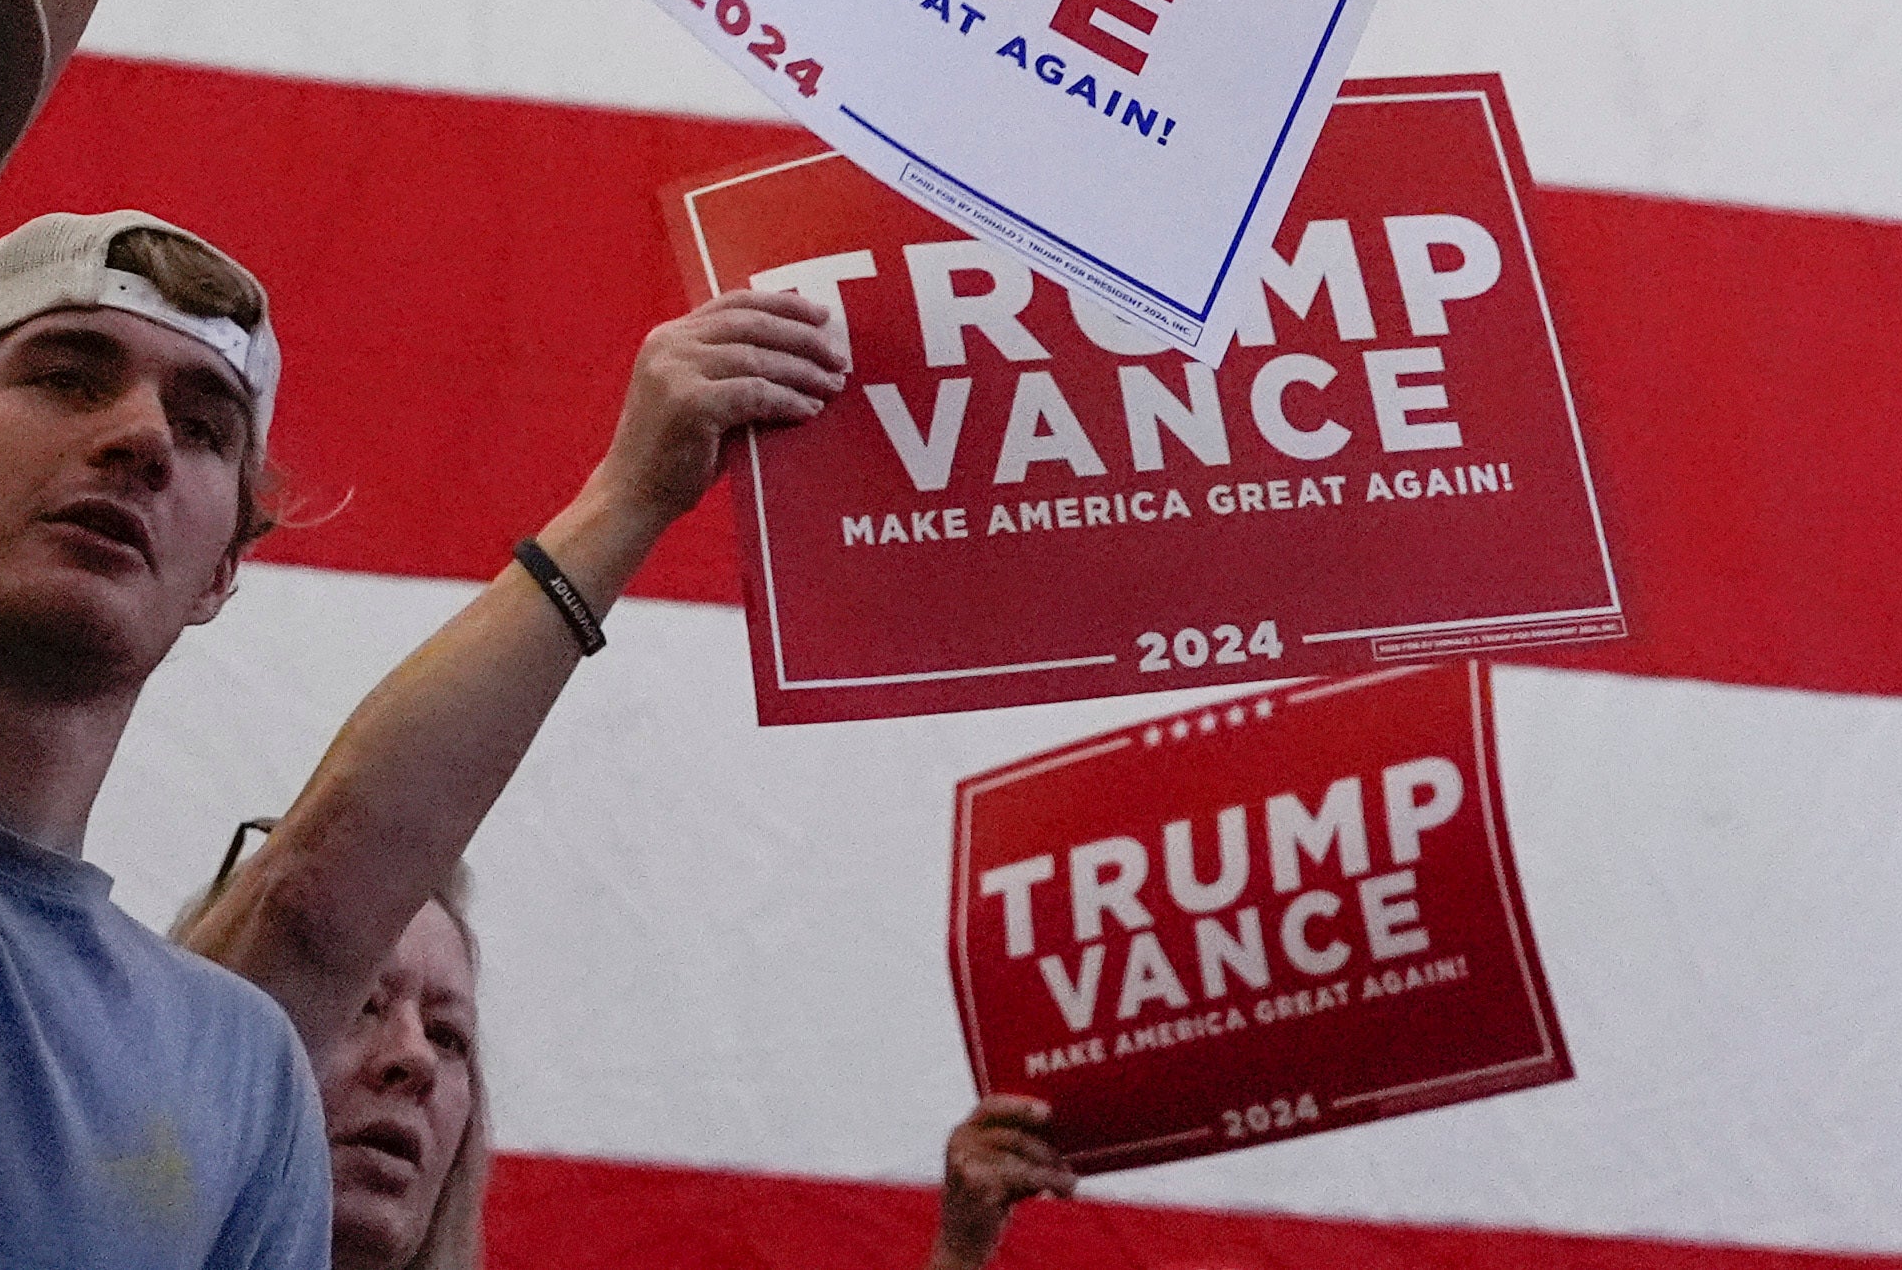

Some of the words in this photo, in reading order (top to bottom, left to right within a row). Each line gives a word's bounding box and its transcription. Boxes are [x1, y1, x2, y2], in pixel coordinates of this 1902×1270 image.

[996, 35, 1177, 147] AGAIN!
[973, 210, 1016, 239] DONALD
[1029, 242, 1063, 264] TRUMP
[1064, 261, 1086, 278] FOR
[1087, 274, 1144, 309] PRESIDENT
[1172, 320, 1192, 337] INC.
[866, 347, 1462, 490] VANCE
[843, 509, 967, 544] MAKE
[989, 490, 1189, 533] AMERICA
[1208, 477, 1344, 513] GREAT
[1368, 462, 1514, 500] AGAIN!
[1138, 622, 1282, 671] 2024
[981, 758, 1462, 956] TRUMP
[1041, 871, 1427, 1029] VANCE
[1024, 1038, 1106, 1079] MAKE
[1114, 1007, 1246, 1057] AMERICA
[1253, 980, 1350, 1024] GREAT
[1361, 955, 1468, 1000] AGAIN!
[1220, 1092, 1320, 1140] 2024
